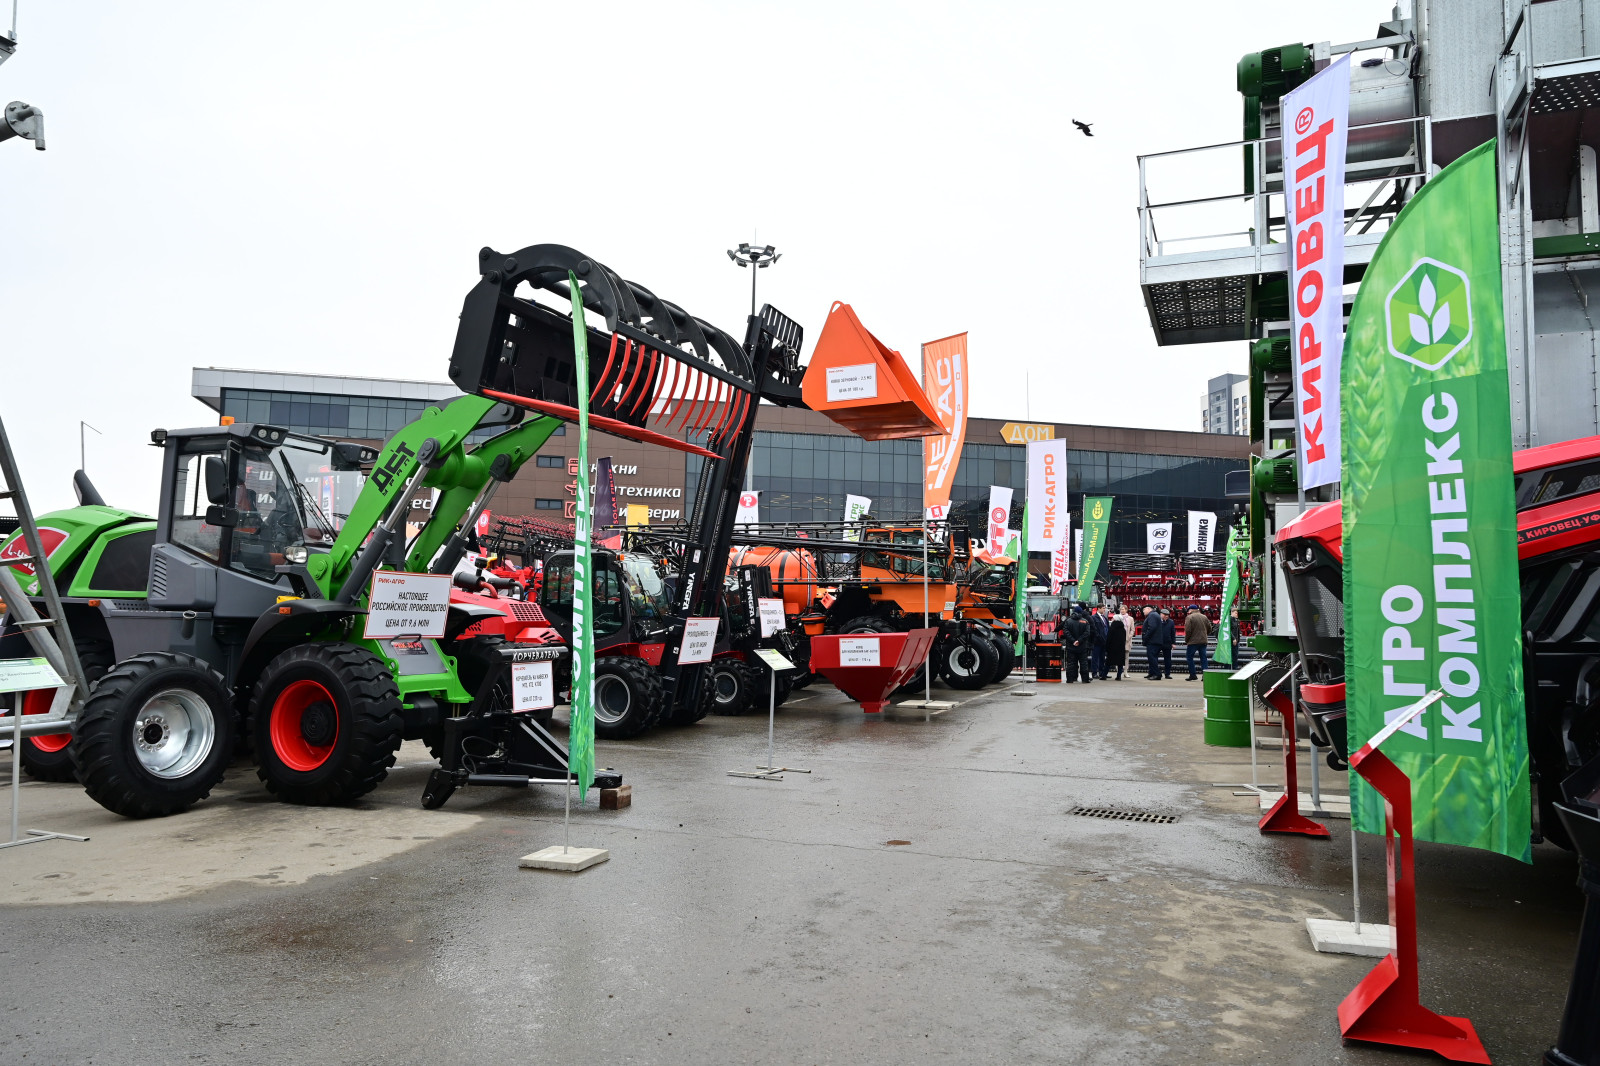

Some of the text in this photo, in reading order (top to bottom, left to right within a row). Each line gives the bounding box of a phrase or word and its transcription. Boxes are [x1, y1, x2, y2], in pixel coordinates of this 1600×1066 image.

[1010, 424, 1050, 442] ДОМ
[590, 463, 638, 475] кхни
[589, 486, 682, 498] стехника
[648, 508, 681, 522] вери
[1526, 514, 1600, 539] КИРОВЕЦ-УФ
[1196, 518, 1209, 552] ехника
[1422, 391, 1484, 743] КОМПЛЕКС
[398, 592, 428, 601] НАСТОЯЩЕЕ
[682, 572, 696, 610] YINGFA
[372, 601, 446, 612] РОССИЙСКОЕ ПРОИЗВОДСТВО
[746, 584, 755, 617] YINGFA
[386, 619, 400, 628] ЦЕНА
[400, 619, 408, 627] ОТ
[417, 619, 430, 627] МЛН
[512, 650, 560, 661] КОРЧЕВАТЕЛЬ
[1381, 583, 1429, 740] АГРО
